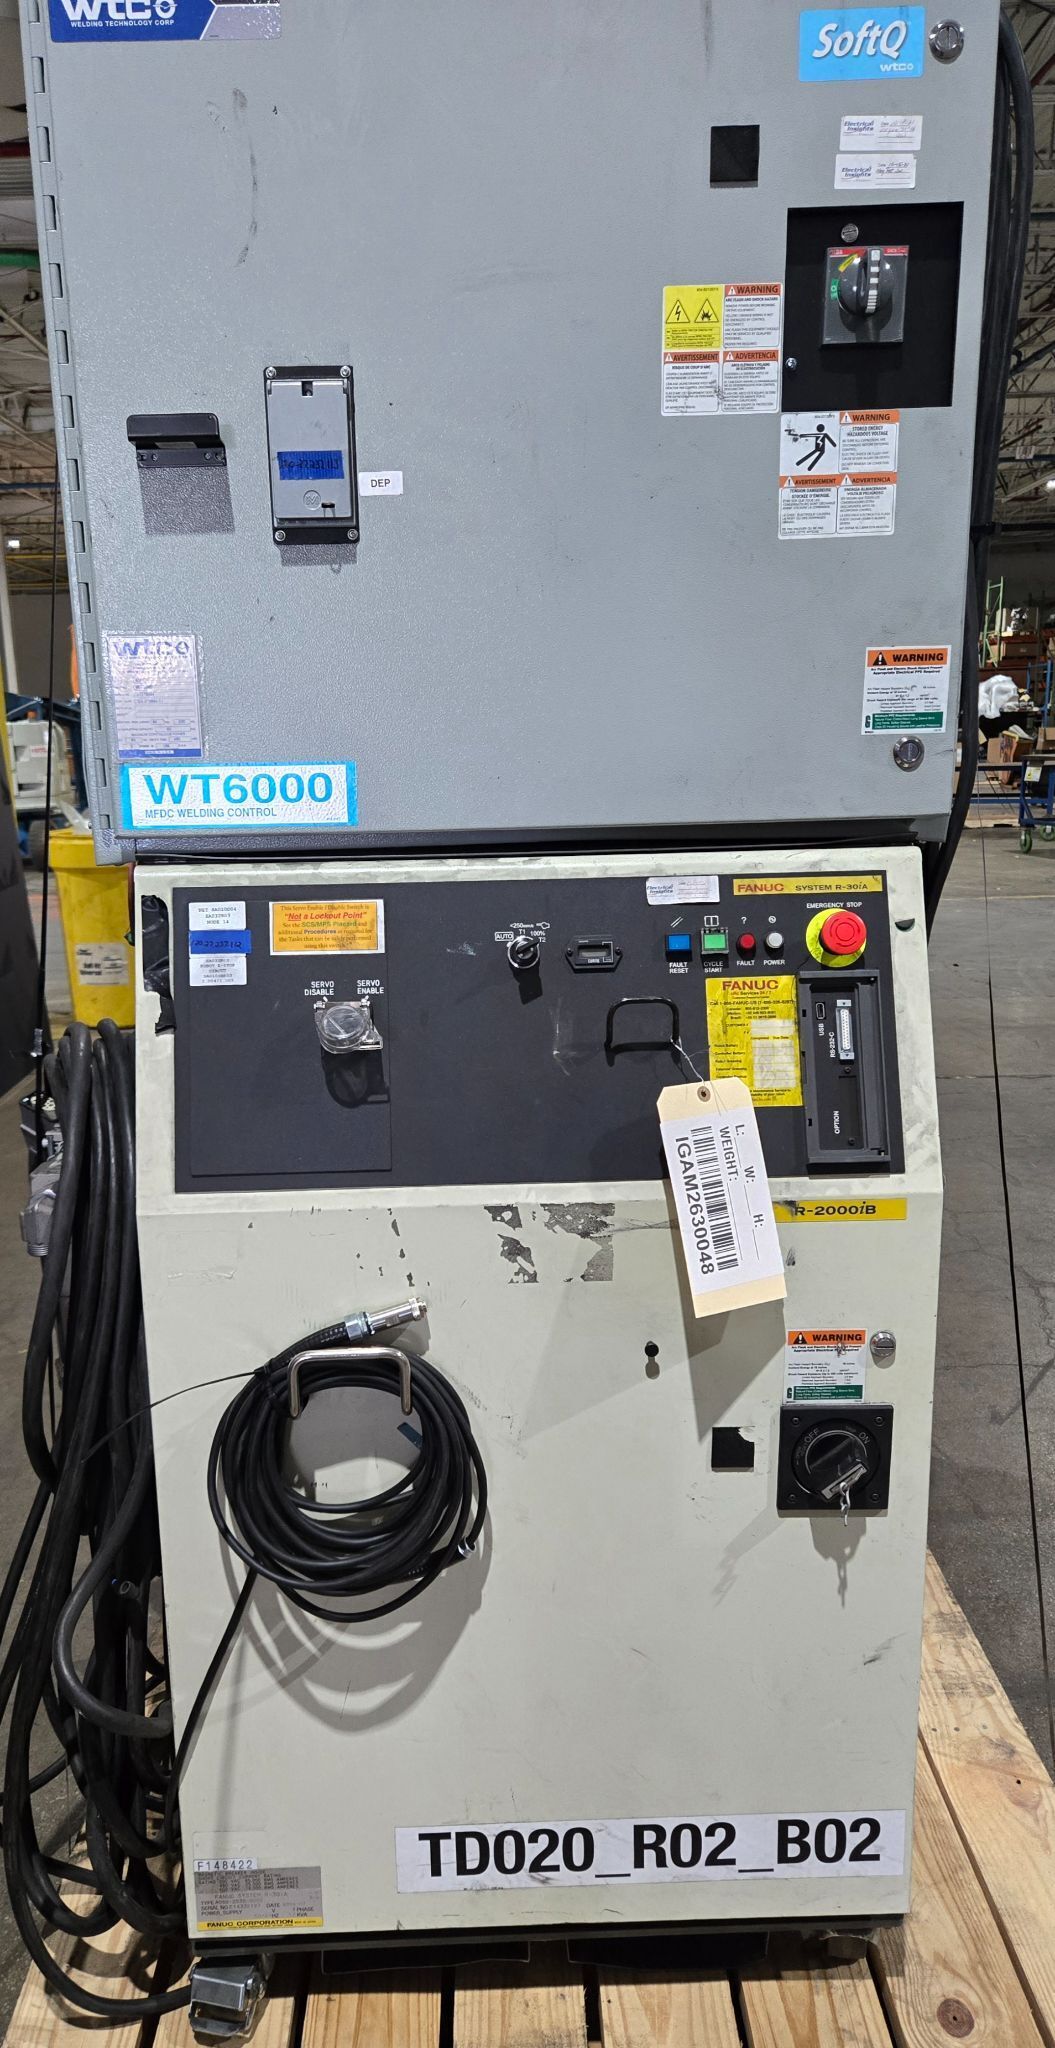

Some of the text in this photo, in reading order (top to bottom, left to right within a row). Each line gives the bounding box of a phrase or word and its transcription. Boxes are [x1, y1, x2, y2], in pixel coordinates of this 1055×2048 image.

[71, 20, 103, 28] WELDING
[812, 19, 908, 60] SoftQ
[737, 285, 779, 294] WARNING
[674, 353, 719, 361] AVERTISSEMENT
[735, 351, 777, 360] ADVERTENCIA
[852, 413, 891, 421] WARNING
[370, 478, 391, 488] DEP
[892, 653, 944, 663] WARNING
[142, 772, 333, 805] WT6000
[145, 807, 278, 819] MFDC WELDING CONTROL
[738, 883, 785, 893] FANUC
[795, 884, 832, 892] SYSTEM
[806, 901, 844, 909] EMERGENCY
[310, 912, 341, 920] Lockout
[311, 980, 335, 988] SERVO
[356, 979, 380, 987] SERVO
[722, 979, 779, 991] FANUC
[304, 988, 335, 996] DISABLE
[356, 987, 385, 995] ENABLE
[719, 1126, 739, 1182] WEIGHT:
[735, 1124, 764, 1228] L: W: H:
[675, 1136, 715, 1275] IGAM2630048
[812, 1333, 862, 1342] WARNING
[803, 1427, 871, 1444] OFF ON
[418, 1817, 881, 1877] TD020_R02_B02
[197, 1859, 253, 1872] F148422
[236, 1919, 294, 1927] CORPORATION
